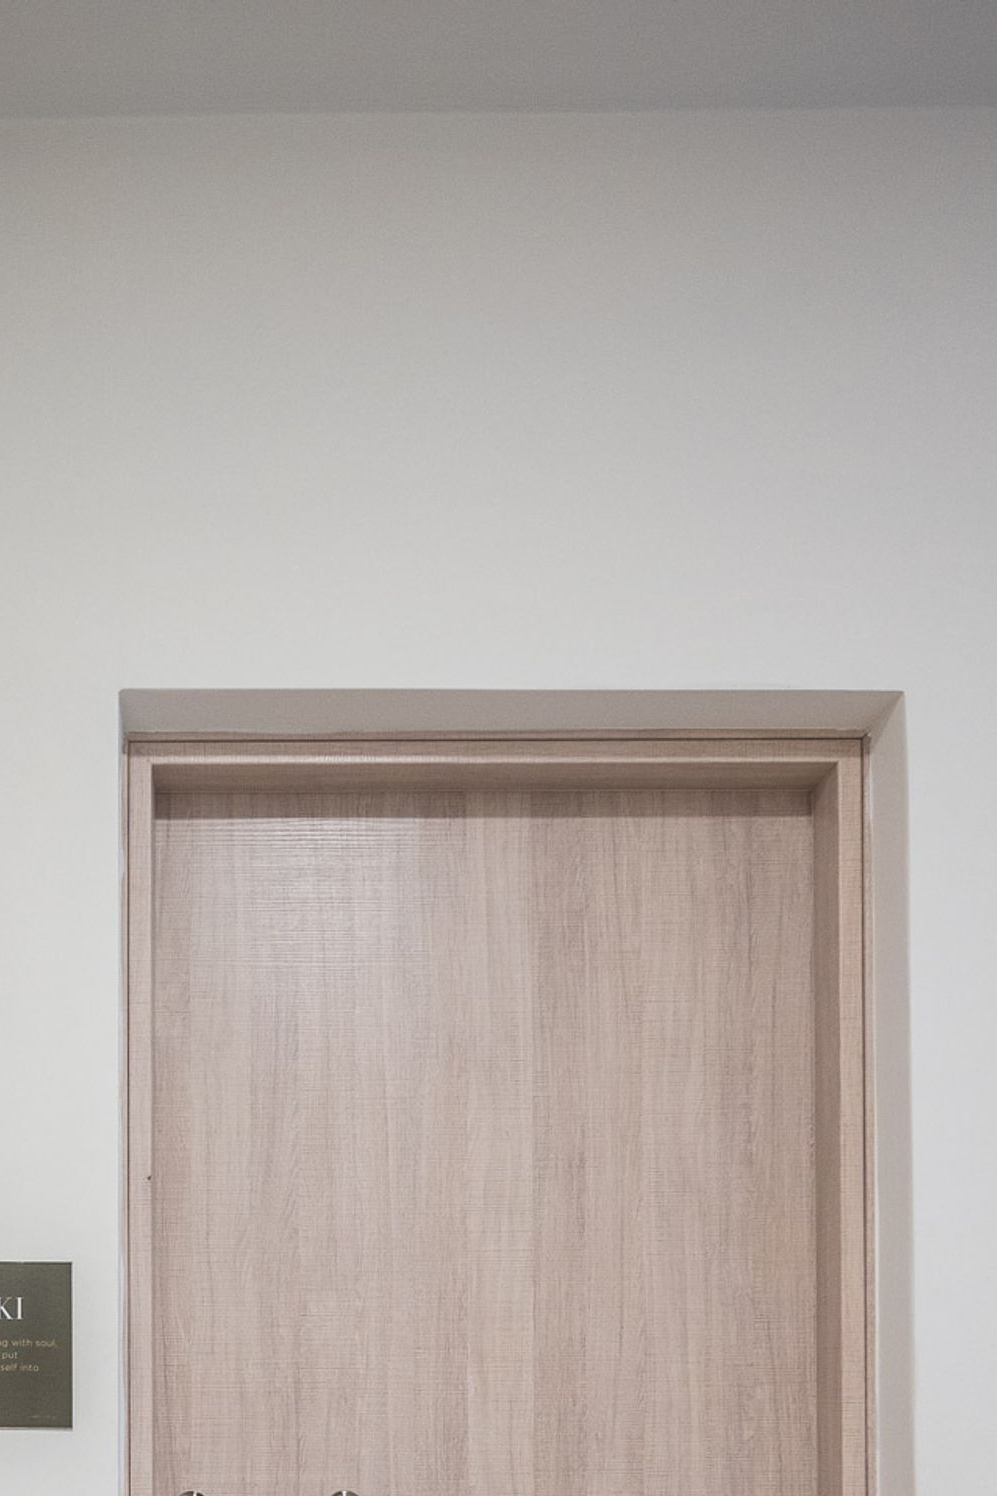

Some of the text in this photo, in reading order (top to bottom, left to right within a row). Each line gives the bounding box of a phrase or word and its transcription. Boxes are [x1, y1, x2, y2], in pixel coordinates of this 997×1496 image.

[11, 1337, 33, 1347] with
[2, 1351, 18, 1361] put
[19, 1363, 39, 1372] into
